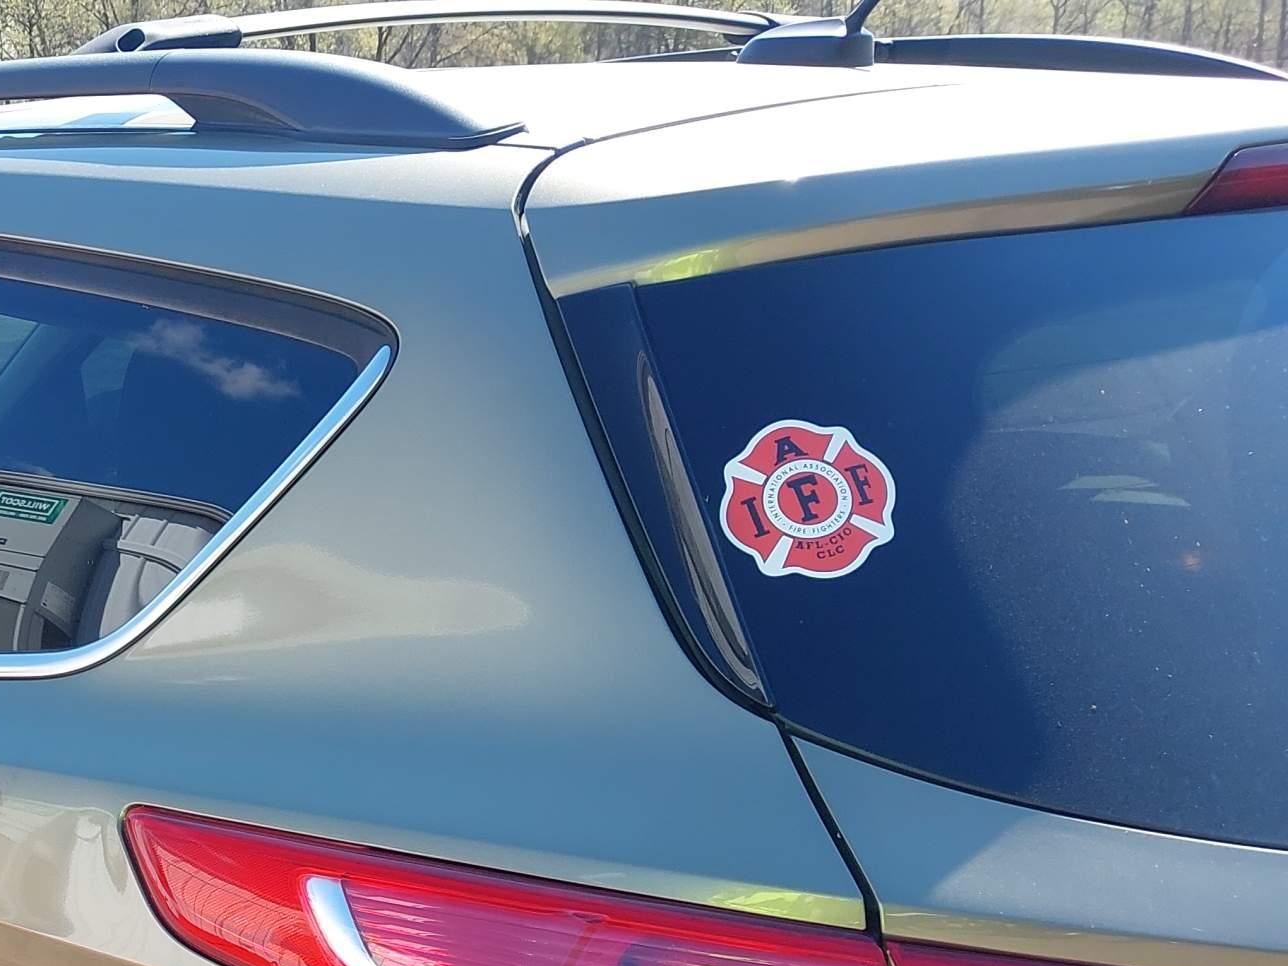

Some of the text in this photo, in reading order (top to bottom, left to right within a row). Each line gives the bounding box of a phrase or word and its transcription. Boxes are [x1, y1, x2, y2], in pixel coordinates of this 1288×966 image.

[774, 436, 808, 466] A
[767, 463, 849, 522] INTERNATIONAL ASSOCIATION
[786, 474, 820, 522] F
[844, 463, 874, 505] F
[740, 496, 771, 538] I
[788, 510, 846, 535] FIRE FIGHTERS
[795, 527, 853, 549] AFL-CIO
[816, 545, 845, 559] CLC
